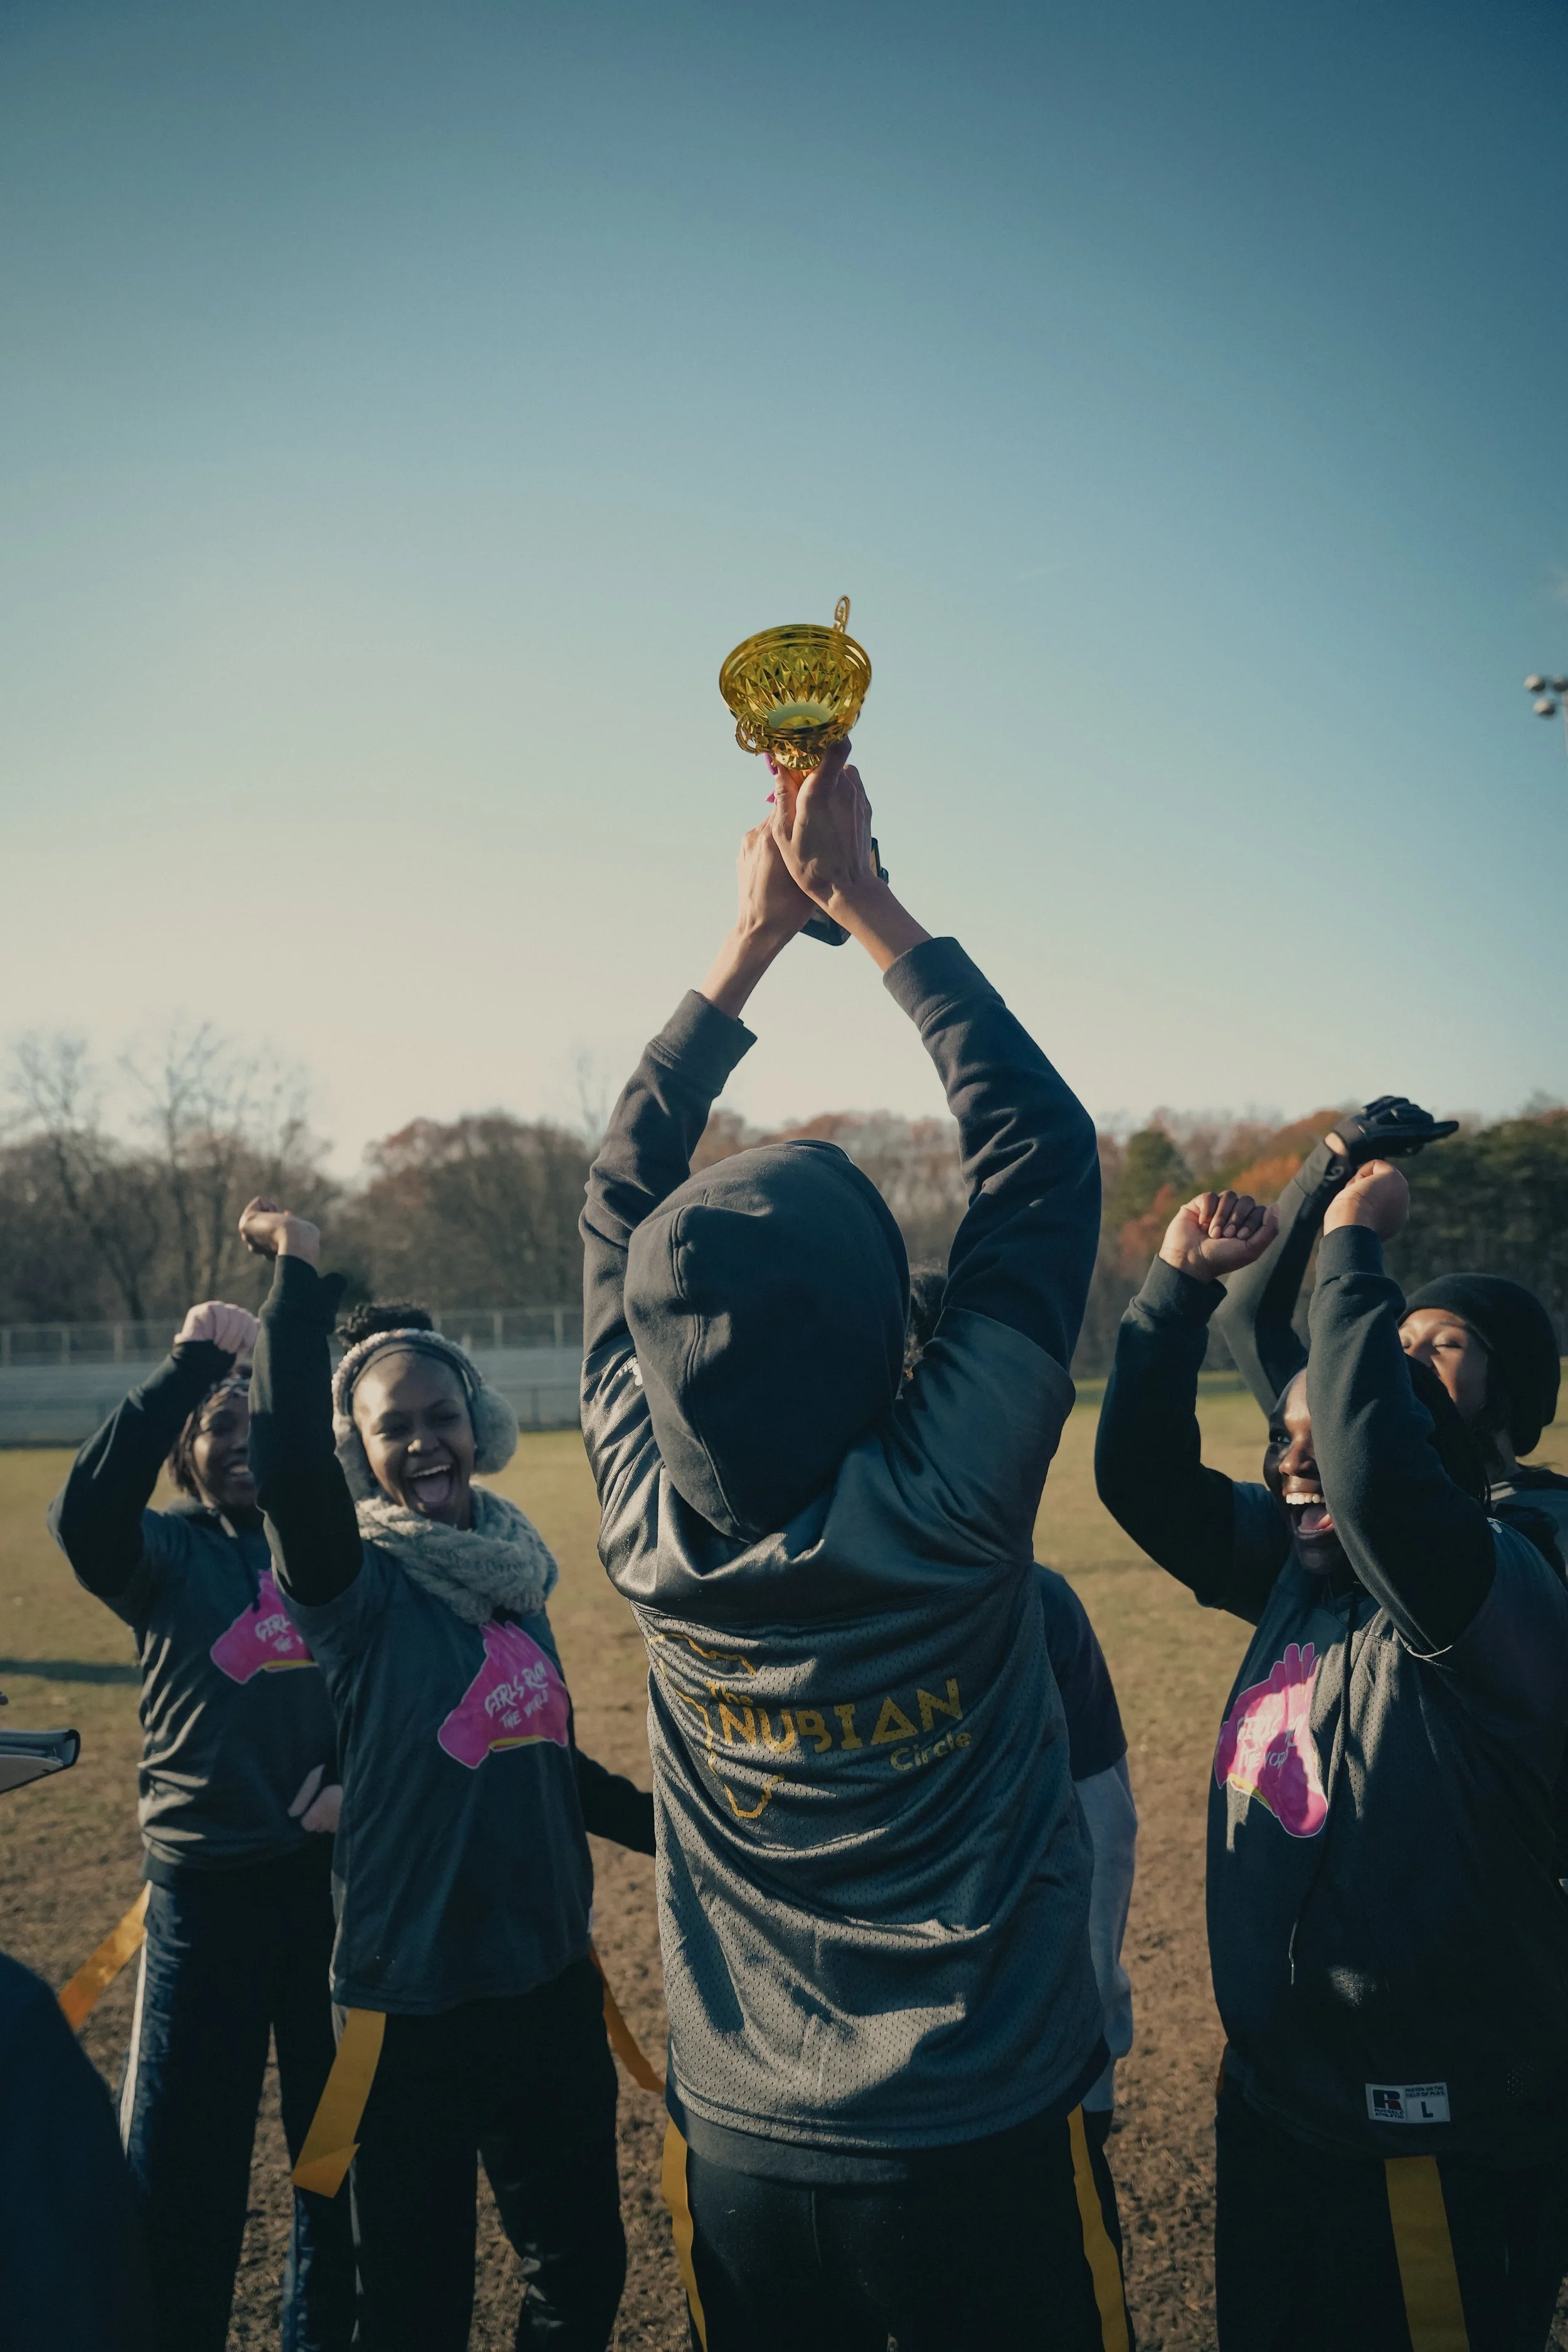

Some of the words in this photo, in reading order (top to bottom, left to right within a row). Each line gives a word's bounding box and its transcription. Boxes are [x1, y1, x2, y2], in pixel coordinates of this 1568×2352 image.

[255, 1613, 292, 1643] GIRL
[706, 1680, 753, 1707] The
[718, 1678, 963, 1753] NUBIAN
[890, 1730, 972, 1771] Circle
[1421, 2101, 1434, 2118] L
